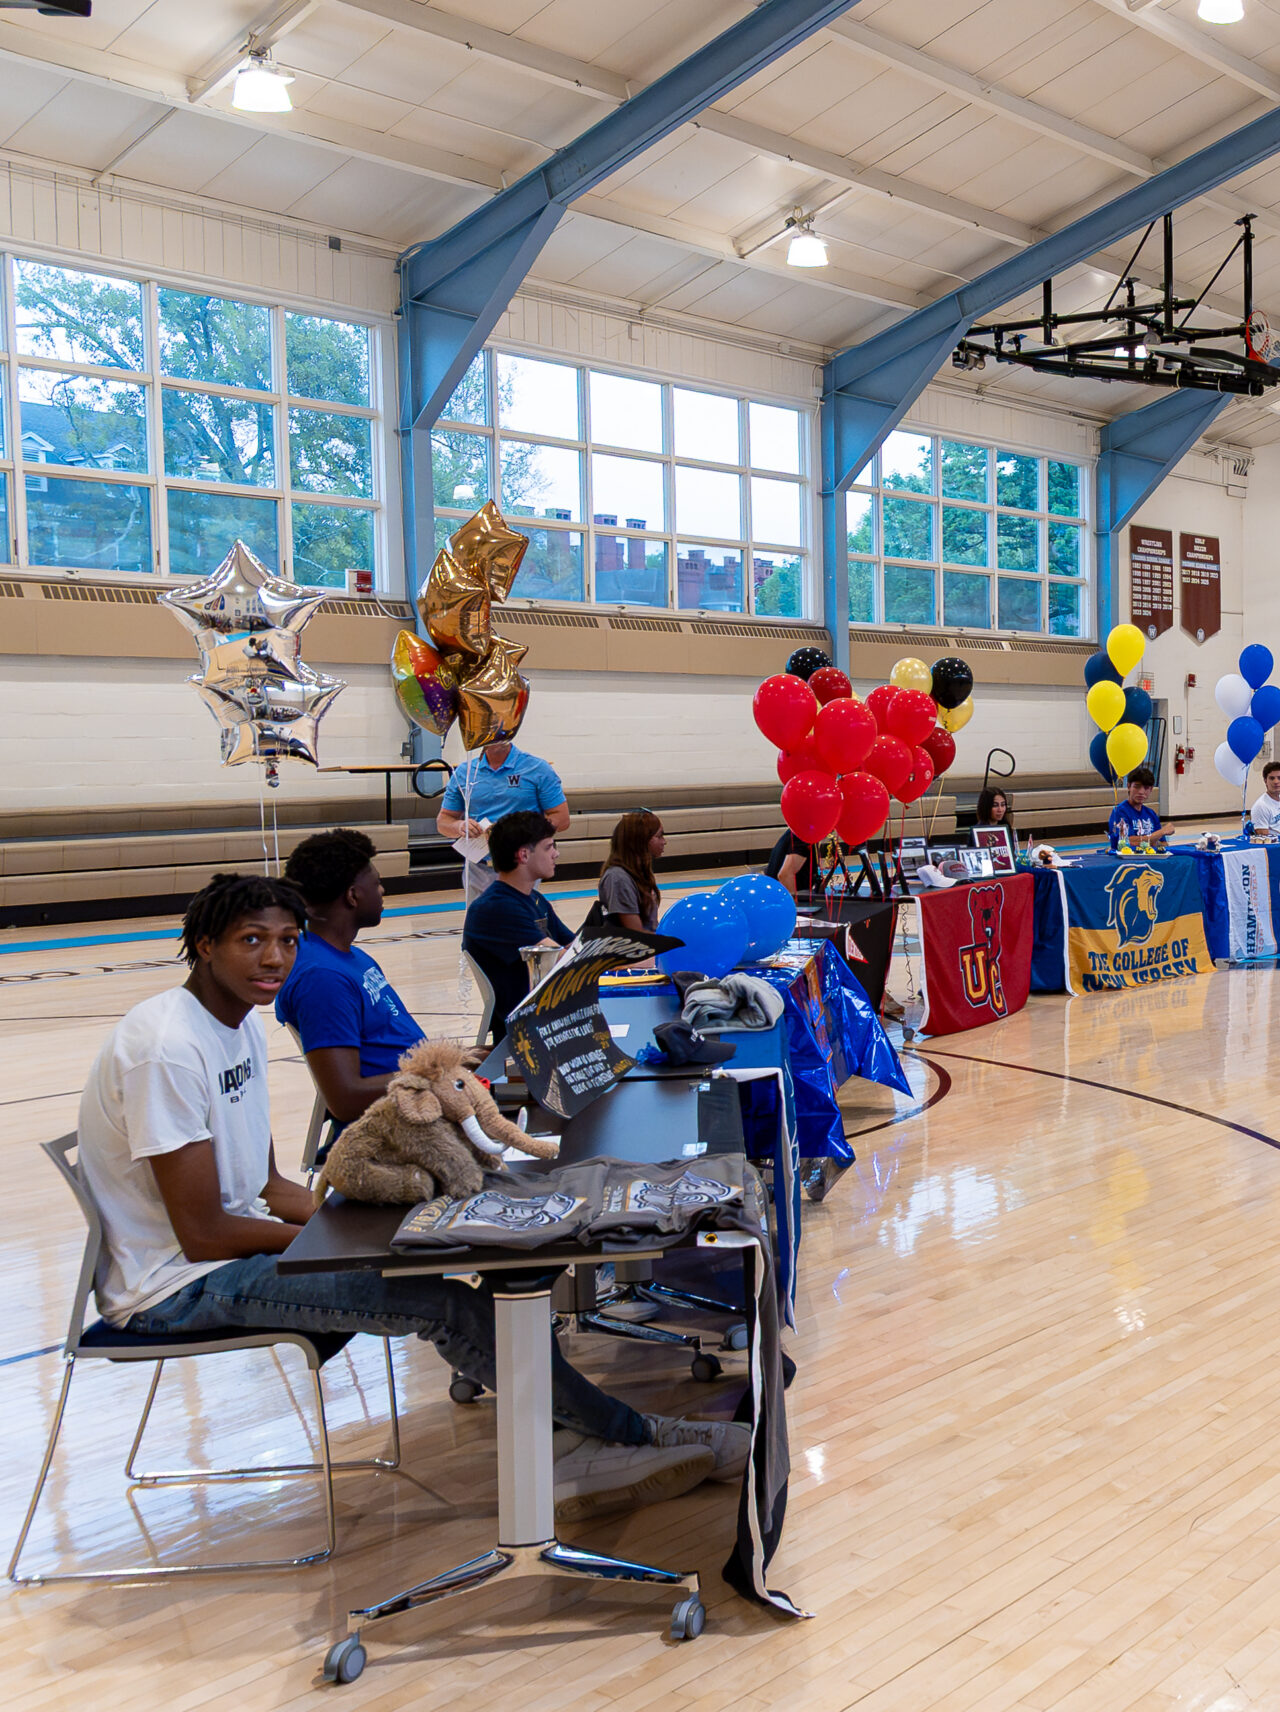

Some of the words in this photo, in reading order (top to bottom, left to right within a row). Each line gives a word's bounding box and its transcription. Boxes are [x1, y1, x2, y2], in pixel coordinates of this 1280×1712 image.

[508, 775, 520, 786] W
[1113, 944, 1169, 972] COLLEGE
[1171, 938, 1189, 959] OF
